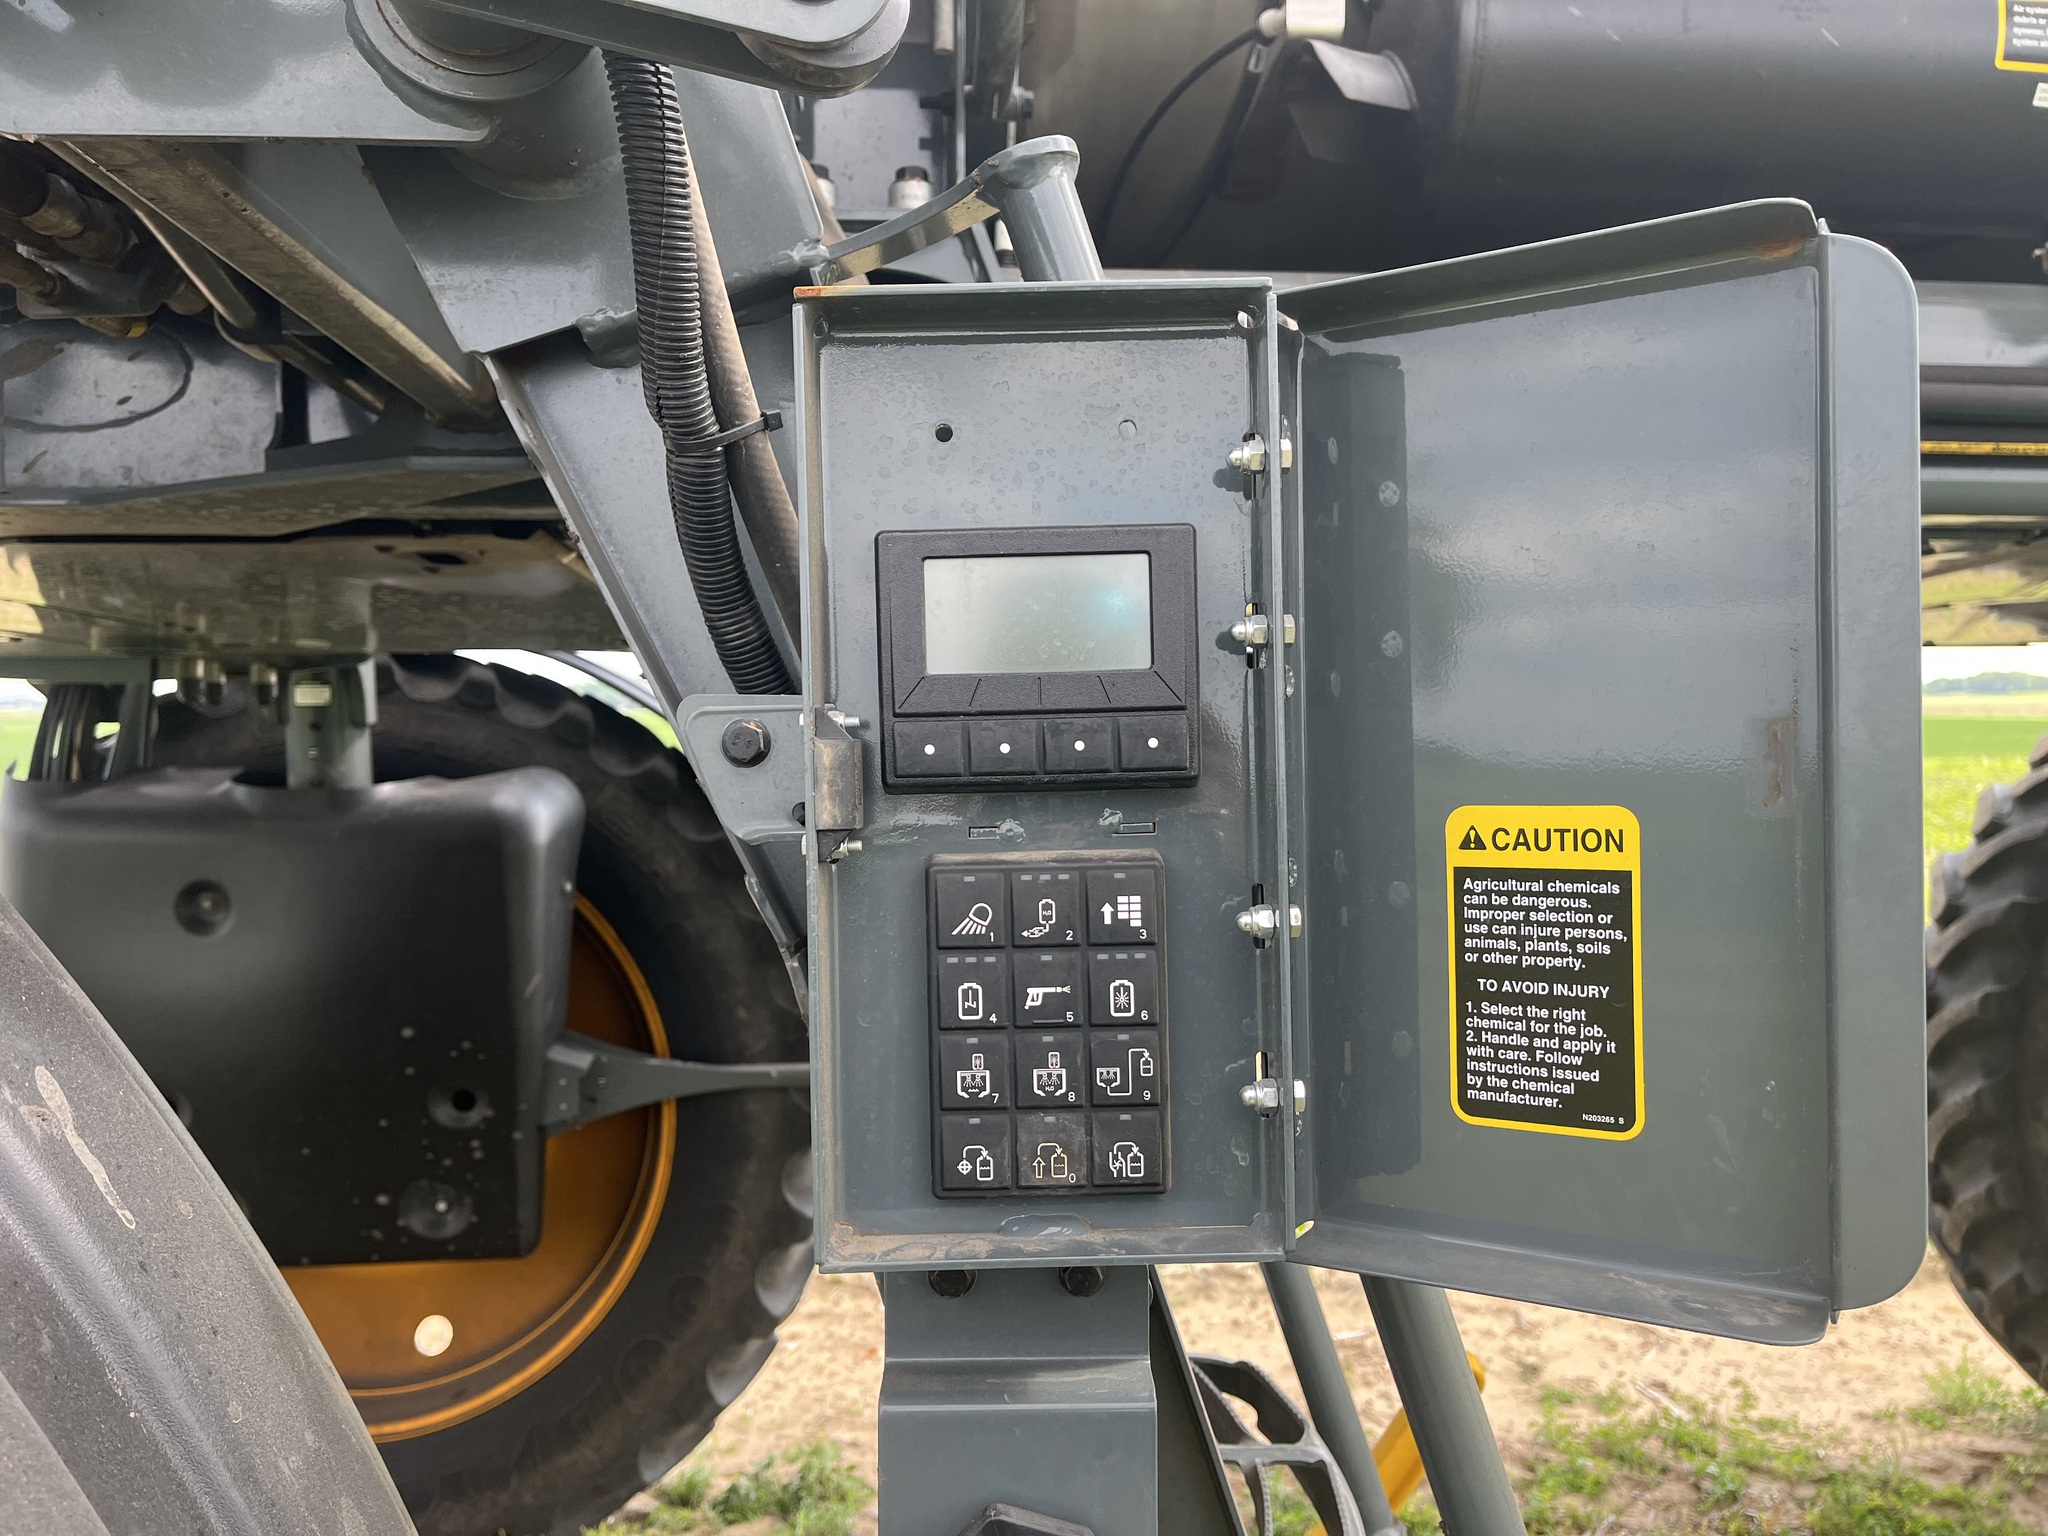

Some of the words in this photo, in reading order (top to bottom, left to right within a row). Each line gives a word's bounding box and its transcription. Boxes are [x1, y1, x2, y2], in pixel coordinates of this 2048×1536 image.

[1492, 828, 1623, 852] CAUTION
[1463, 878, 1543, 893] Agricultural
[1547, 880, 1620, 894] chemicals
[1463, 895, 1488, 905] can
[1492, 893, 1508, 905] be
[1512, 894, 1591, 910] dangerous.
[1464, 906, 1526, 923] Improper
[1529, 909, 1593, 923] selection
[1598, 914, 1613, 924] or
[990, 932, 994, 942] 1
[1066, 930, 1073, 940] 2
[1139, 929, 1147, 939] 3
[1464, 924, 1488, 934] use
[1492, 925, 1516, 935] can
[1521, 923, 1561, 937] injure
[1565, 928, 1627, 942] persons,
[1464, 936, 1521, 952] animals,
[1525, 940, 1572, 955] plants,
[1576, 941, 1611, 955] soils
[1465, 953, 1479, 962] or
[1482, 951, 1518, 964] other
[1522, 955, 1585, 971] property.
[1477, 978, 1498, 991] TO
[1502, 980, 1549, 995] AVOID
[1553, 983, 1610, 999] INJURY
[989, 1013, 997, 1023] 4
[1066, 1011, 1074, 1022] 5
[1141, 1010, 1148, 1020] 6
[1466, 1001, 1477, 1013] 1.
[1481, 1002, 1523, 1016] Select
[1526, 1005, 1549, 1018] the
[1553, 1007, 1586, 1023] right
[1466, 1015, 1526, 1031] chemical
[1530, 1020, 1550, 1033] for
[1553, 1022, 1576, 1035] the
[1580, 1023, 1607, 1039] job.
[1466, 1030, 1478, 1042] 2.
[1482, 1031, 1529, 1046] Handle
[1533, 1036, 1559, 1049] and
[1563, 1039, 1602, 1055] apply
[1607, 1040, 1616, 1053] it
[1466, 1045, 1494, 1058] with
[1498, 1049, 1531, 1061] care.
[1536, 1050, 1583, 1066] Follow
[1467, 1058, 1548, 1077] instructions
[1552, 1066, 1599, 1082] issued
[1467, 1073, 1483, 1088] by
[1486, 1075, 1508, 1088] the
[1512, 1078, 1574, 1094] chemical
[992, 1093, 999, 1103] 7
[1068, 1092, 1075, 1102] 8
[1143, 1090, 1151, 1100] 9
[1467, 1089, 1562, 1108] manufacturer.
[1582, 1113, 1615, 1123] N203265
[1069, 1173, 1076, 1183] 0
